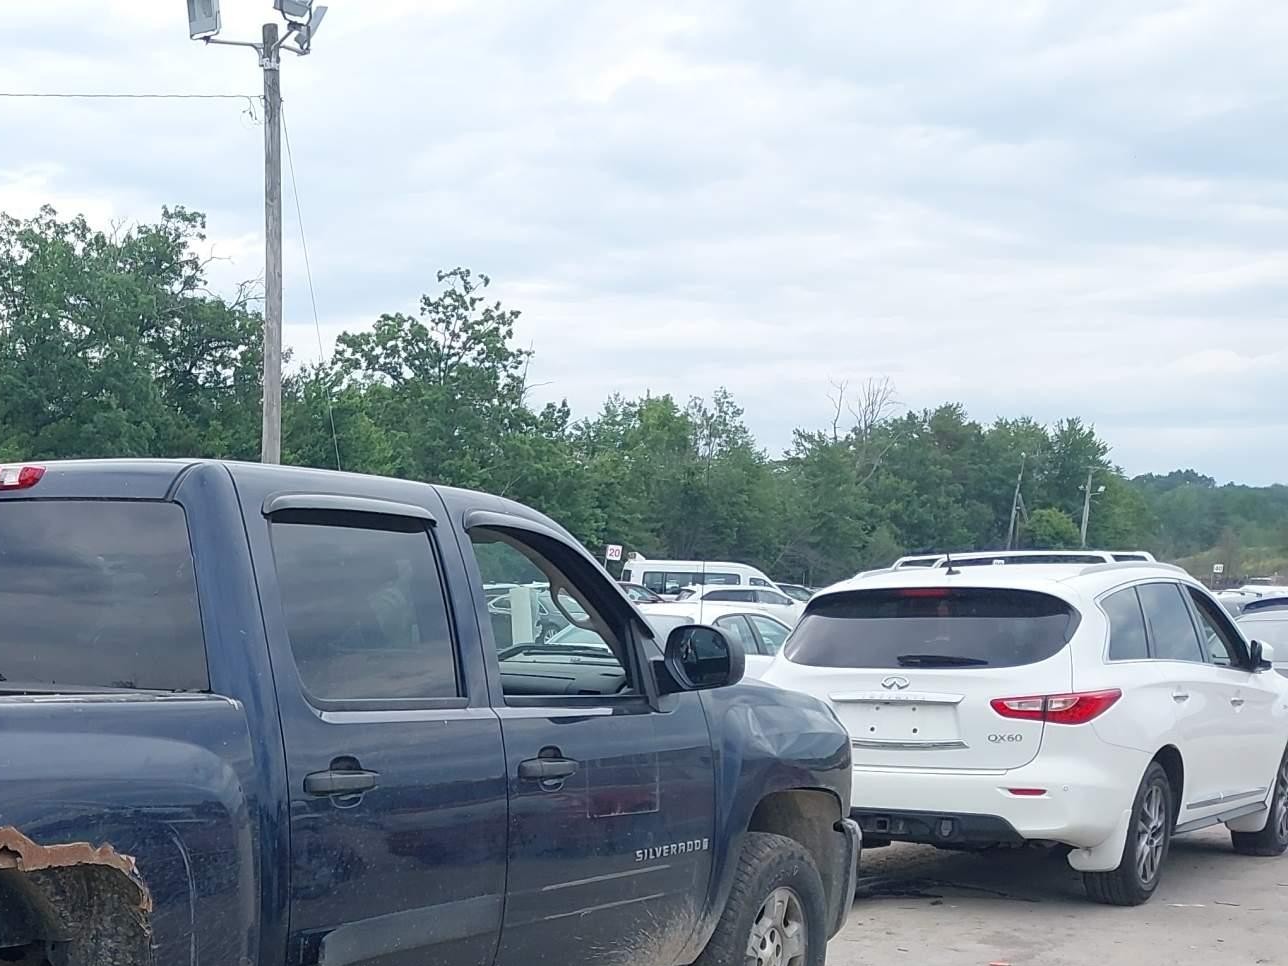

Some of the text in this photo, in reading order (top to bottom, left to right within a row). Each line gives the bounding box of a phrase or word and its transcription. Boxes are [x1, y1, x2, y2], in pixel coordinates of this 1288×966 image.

[608, 548, 621, 558] 20
[987, 733, 1023, 744] QX60
[635, 839, 702, 862] SILVERADO
